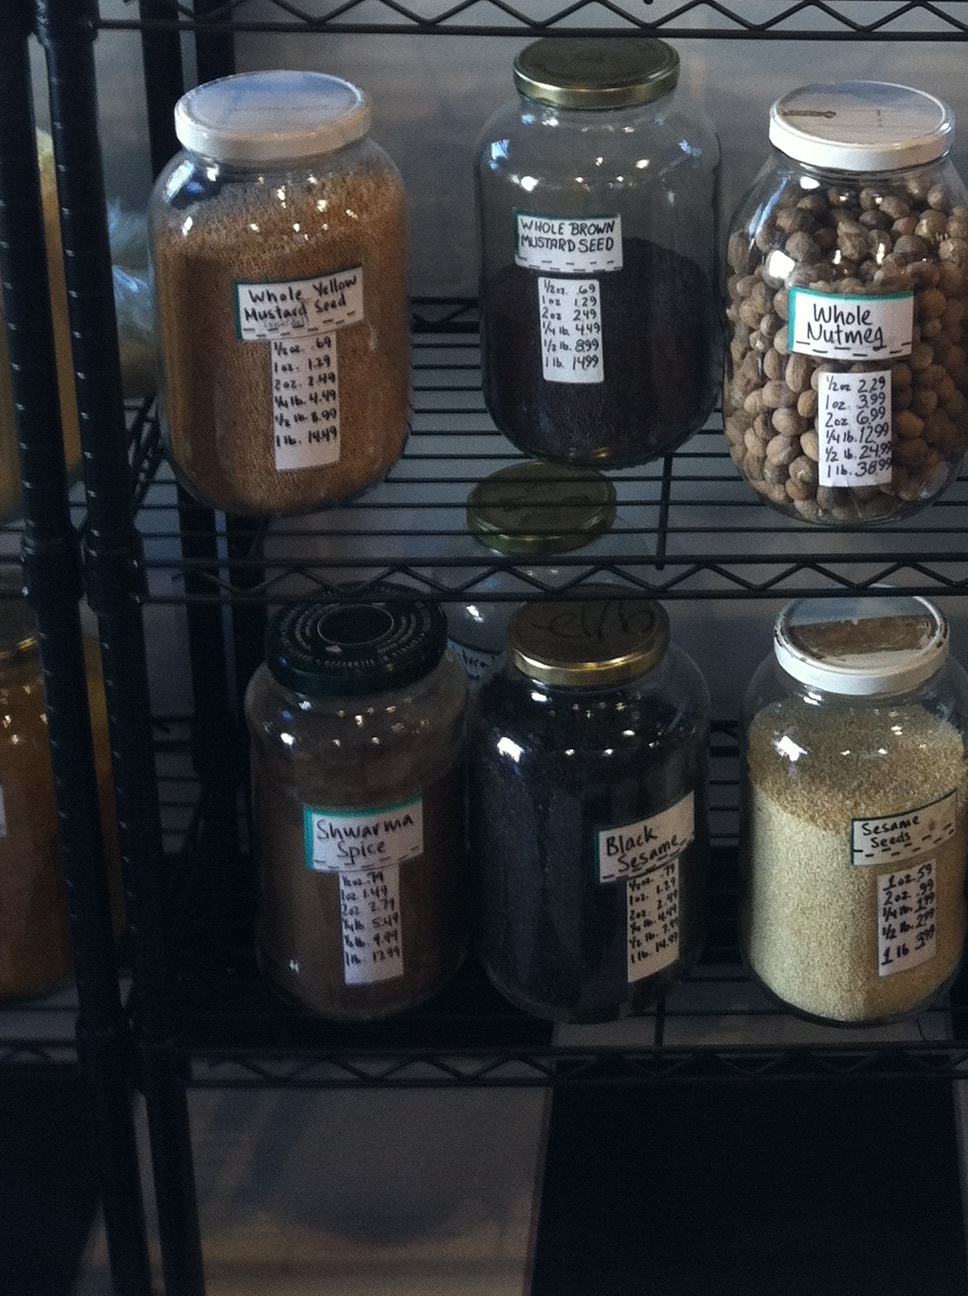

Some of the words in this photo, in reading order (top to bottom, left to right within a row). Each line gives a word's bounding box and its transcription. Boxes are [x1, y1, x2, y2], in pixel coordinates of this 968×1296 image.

[521, 219, 565, 235] WHOLE
[569, 220, 615, 236] BROWN
[521, 236, 576, 252] MUSTARD
[578, 237, 614, 253] SEED
[249, 287, 302, 303] Whole
[313, 275, 357, 296] Yellow
[245, 304, 307, 322] Mustard
[315, 293, 347, 313] Seed
[813, 304, 873, 325] Whole
[807, 322, 887, 351] Nutmeg
[316, 814, 413, 840] Shwarma
[862, 815, 920, 836] Sesame
[606, 826, 658, 856] Black
[871, 832, 911, 848] Seeds
[337, 841, 386, 864] Spice
[618, 835, 678, 872] Sesame
